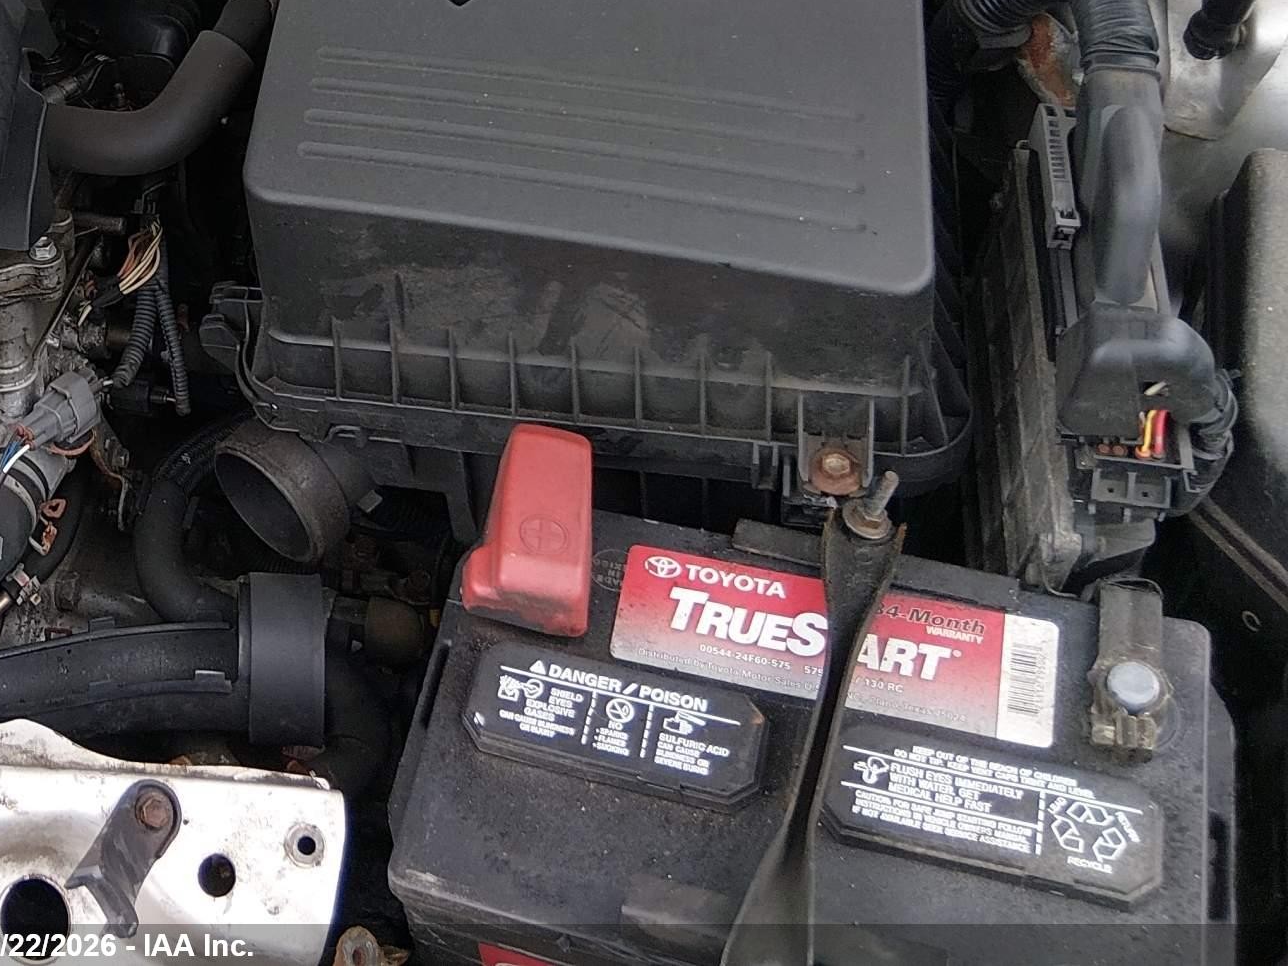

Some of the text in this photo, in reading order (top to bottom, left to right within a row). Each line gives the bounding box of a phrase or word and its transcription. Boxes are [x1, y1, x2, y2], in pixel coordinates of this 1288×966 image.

[686, 563, 786, 599] TOYOTA
[925, 625, 983, 644] WARRANTY
[637, 647, 690, 665] Distributed
[706, 661, 737, 676] Toyota
[741, 670, 771, 683] Motor
[774, 676, 801, 688] Sales
[548, 663, 623, 693] DANGER
[638, 685, 708, 712] POISON
[550, 687, 584, 703] SHIELD
[887, 683, 903, 693] RC
[525, 699, 575, 718] EXPLOSIVE
[548, 696, 573, 708] EYES
[523, 707, 556, 721] GASES
[608, 721, 623, 731] NO
[658, 732, 730, 757] SULFURIC ACID
[935, 750, 954, 761] OUT
[888, 761, 1024, 800] FLUSH EYES IMMEDIATELY
[888, 772, 918, 787] WITH
[957, 787, 980, 800] GET
[886, 782, 992, 812] MEDICAL HELP FAST
